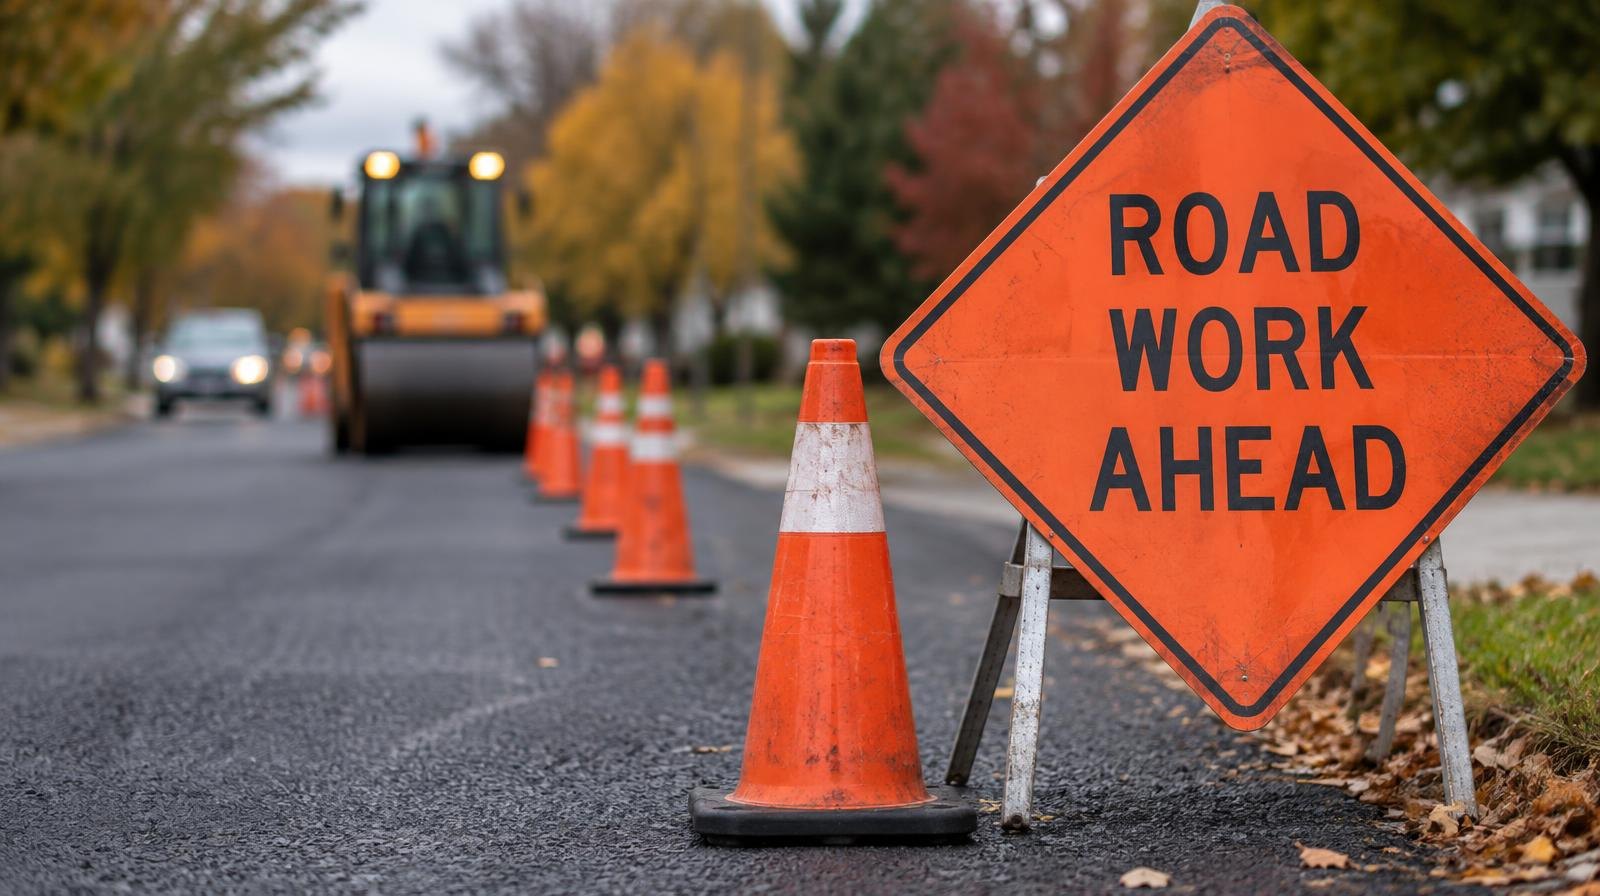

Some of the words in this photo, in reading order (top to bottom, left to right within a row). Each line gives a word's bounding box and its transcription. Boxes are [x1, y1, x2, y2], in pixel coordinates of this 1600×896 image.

[1109, 190, 1361, 276] ROAD
[1108, 305, 1375, 393] WORK
[1089, 425, 1407, 512] AHEAD
